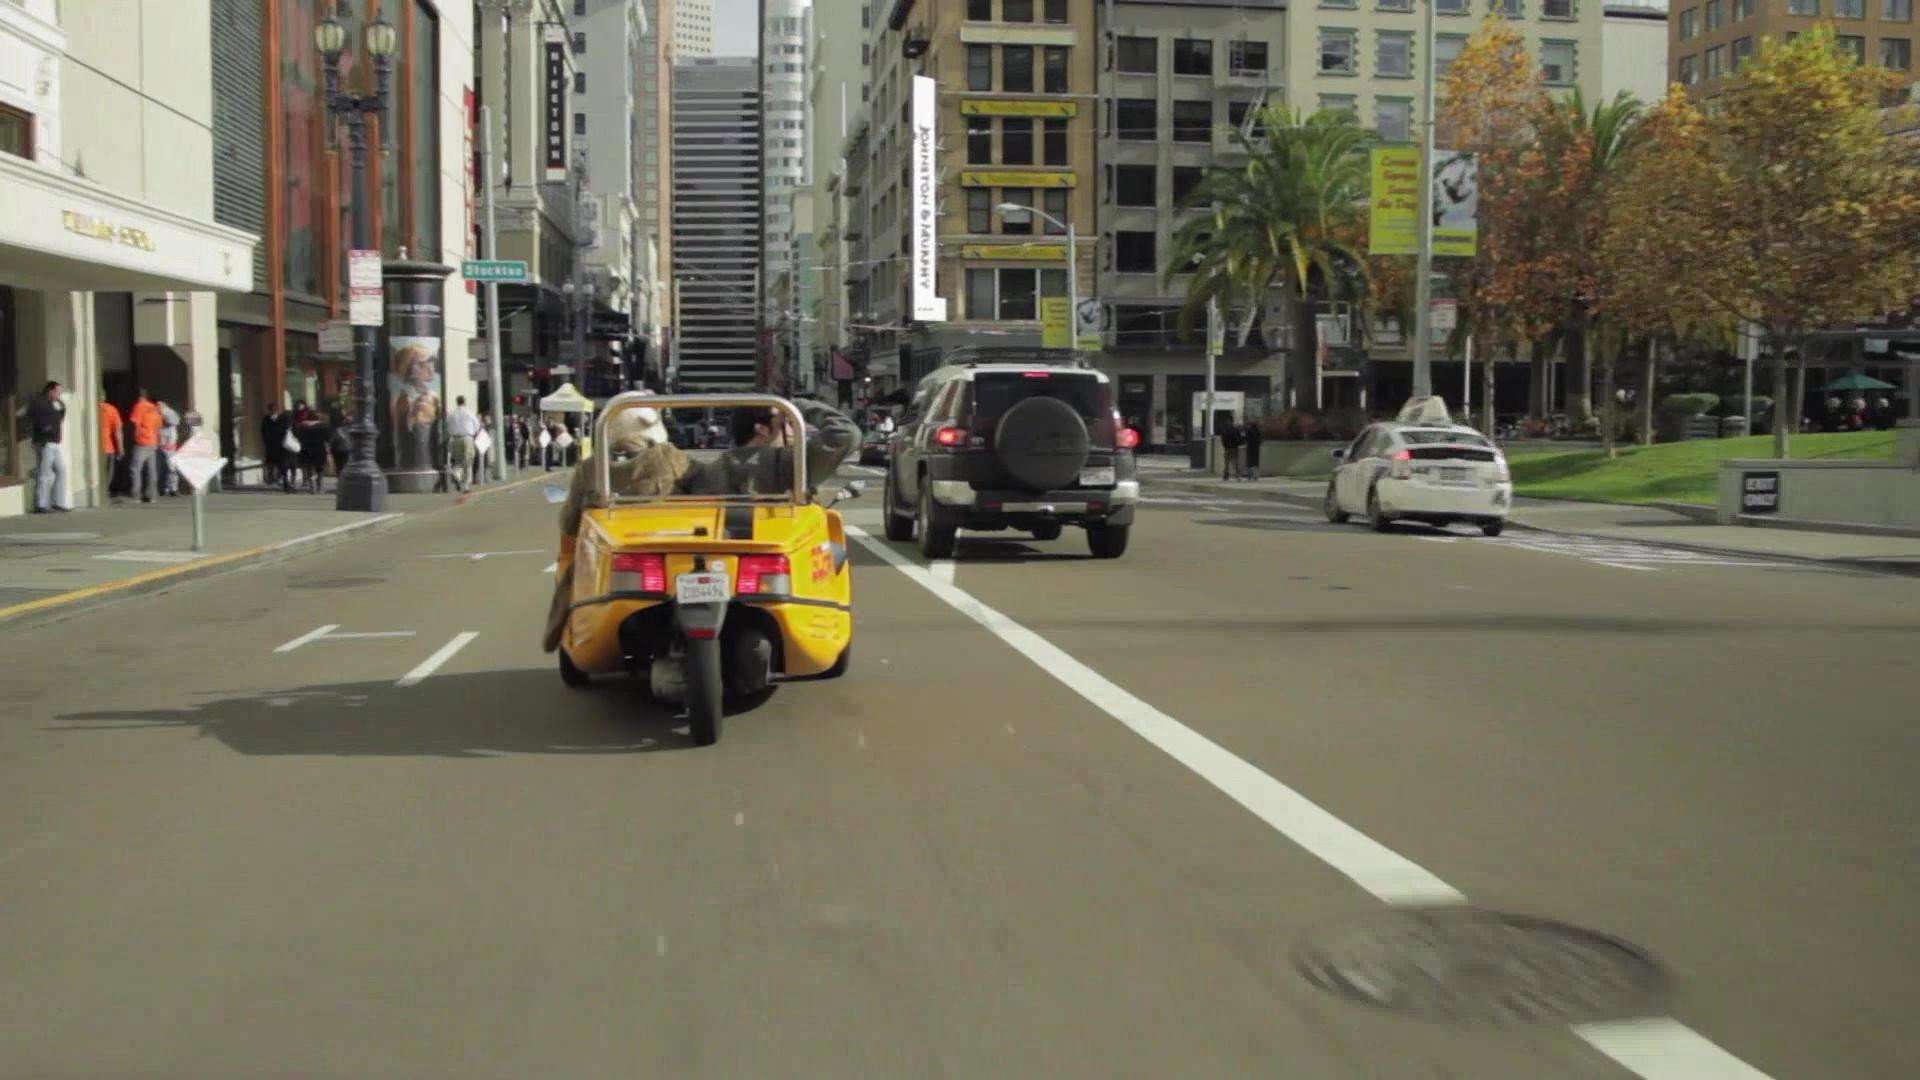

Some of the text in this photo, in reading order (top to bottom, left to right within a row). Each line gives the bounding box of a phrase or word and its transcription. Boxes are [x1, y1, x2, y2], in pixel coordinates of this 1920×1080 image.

[550, 51, 561, 160] NIKETOWN
[919, 126, 932, 290] JOHNSTON & MURPHY
[465, 264, 524, 276] Stockton
